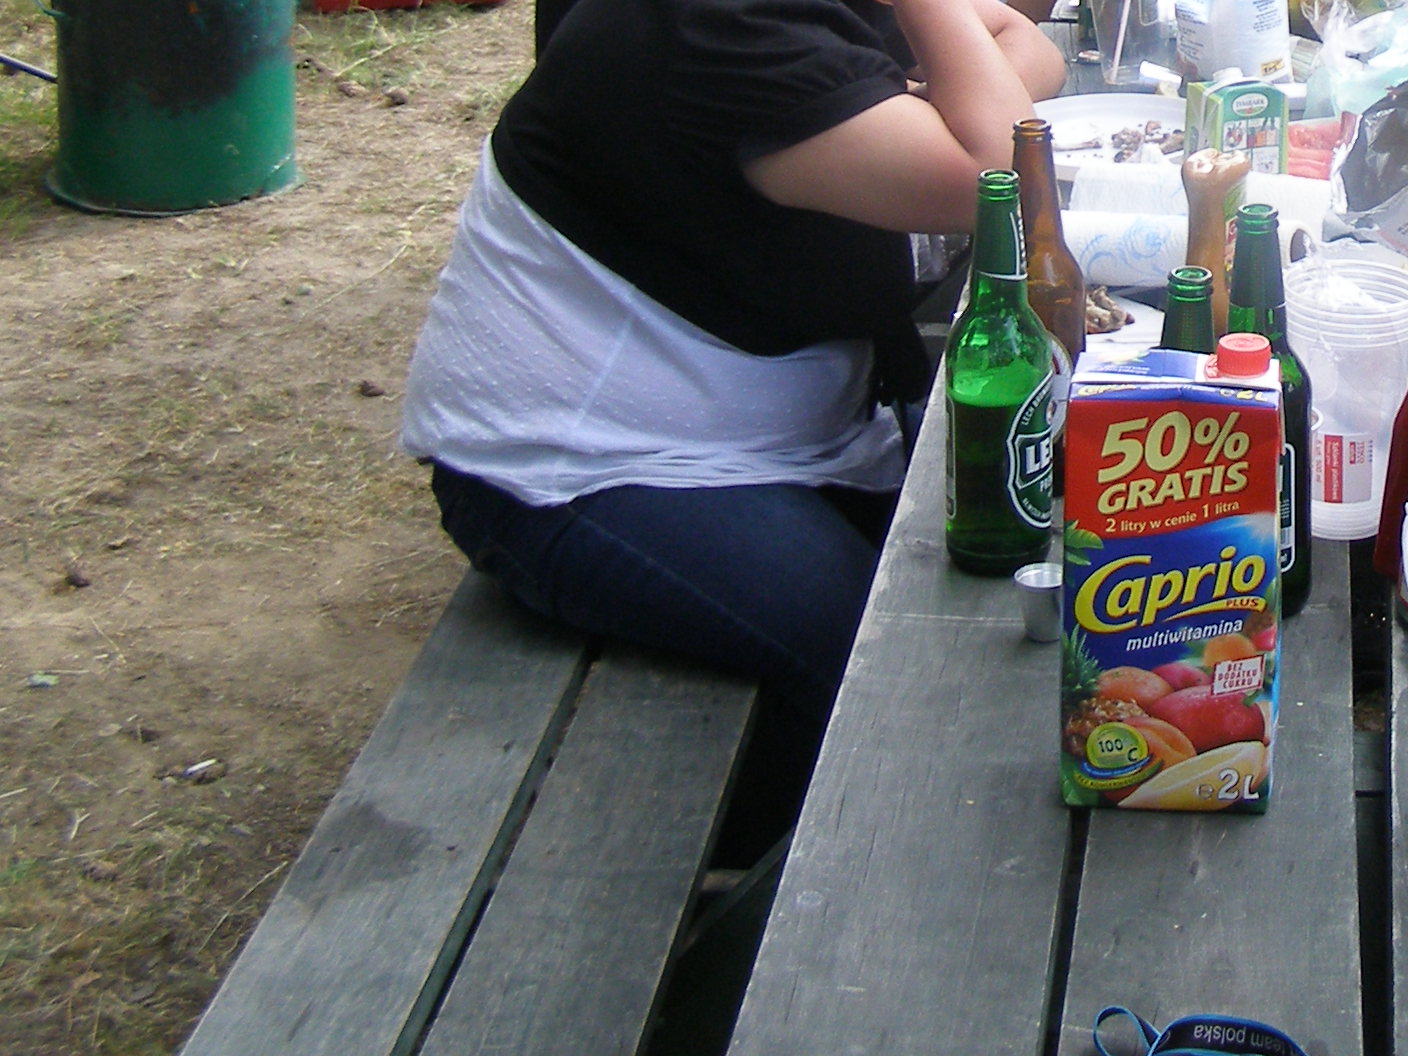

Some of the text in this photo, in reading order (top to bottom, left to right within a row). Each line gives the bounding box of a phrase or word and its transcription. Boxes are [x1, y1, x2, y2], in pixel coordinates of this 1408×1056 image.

[1097, 410, 1250, 484] 50%
[1097, 461, 1249, 515] GRATIS
[1105, 500, 1240, 534] 2 litry w cenie 1 litra
[1074, 545, 1266, 634] Caprio
[1225, 598, 1260, 608] PLUS
[1126, 619, 1244, 652] multiwitamina
[1217, 670, 1258, 681] DODATKU
[1226, 662, 1244, 672] BEZ
[1222, 677, 1254, 690] CUKRU
[1098, 738, 1124, 754] 100
[1193, 1023, 1247, 1045] polska
